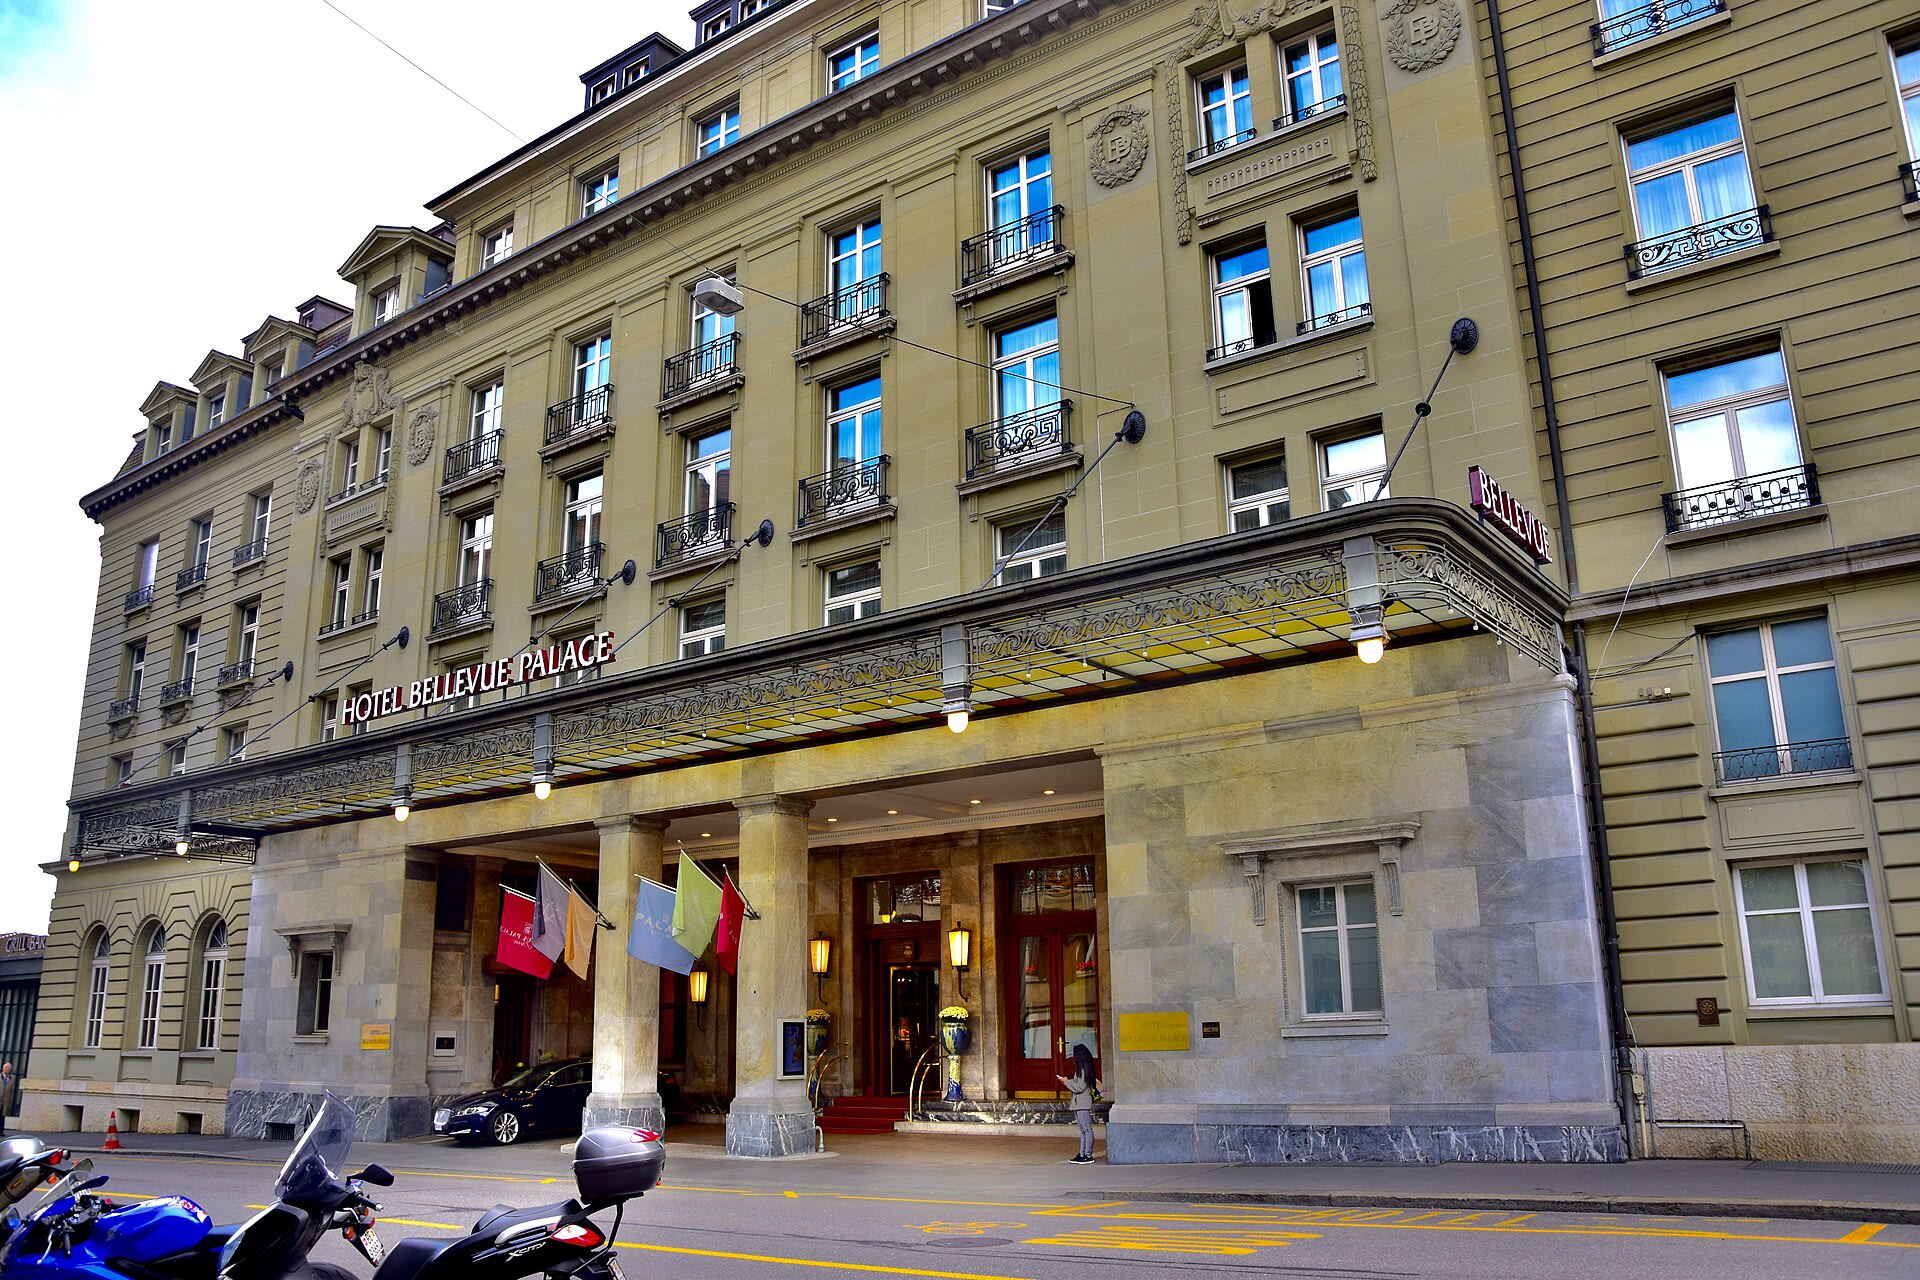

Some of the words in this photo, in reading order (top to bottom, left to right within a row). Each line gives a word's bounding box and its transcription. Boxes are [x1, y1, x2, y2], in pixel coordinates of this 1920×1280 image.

[1478, 466, 1553, 563] BELLEVUE
[341, 686, 405, 725] HOTEL
[409, 657, 513, 710] BELLEVUE
[518, 631, 615, 682] PALACE
[635, 912, 673, 935] PALA
